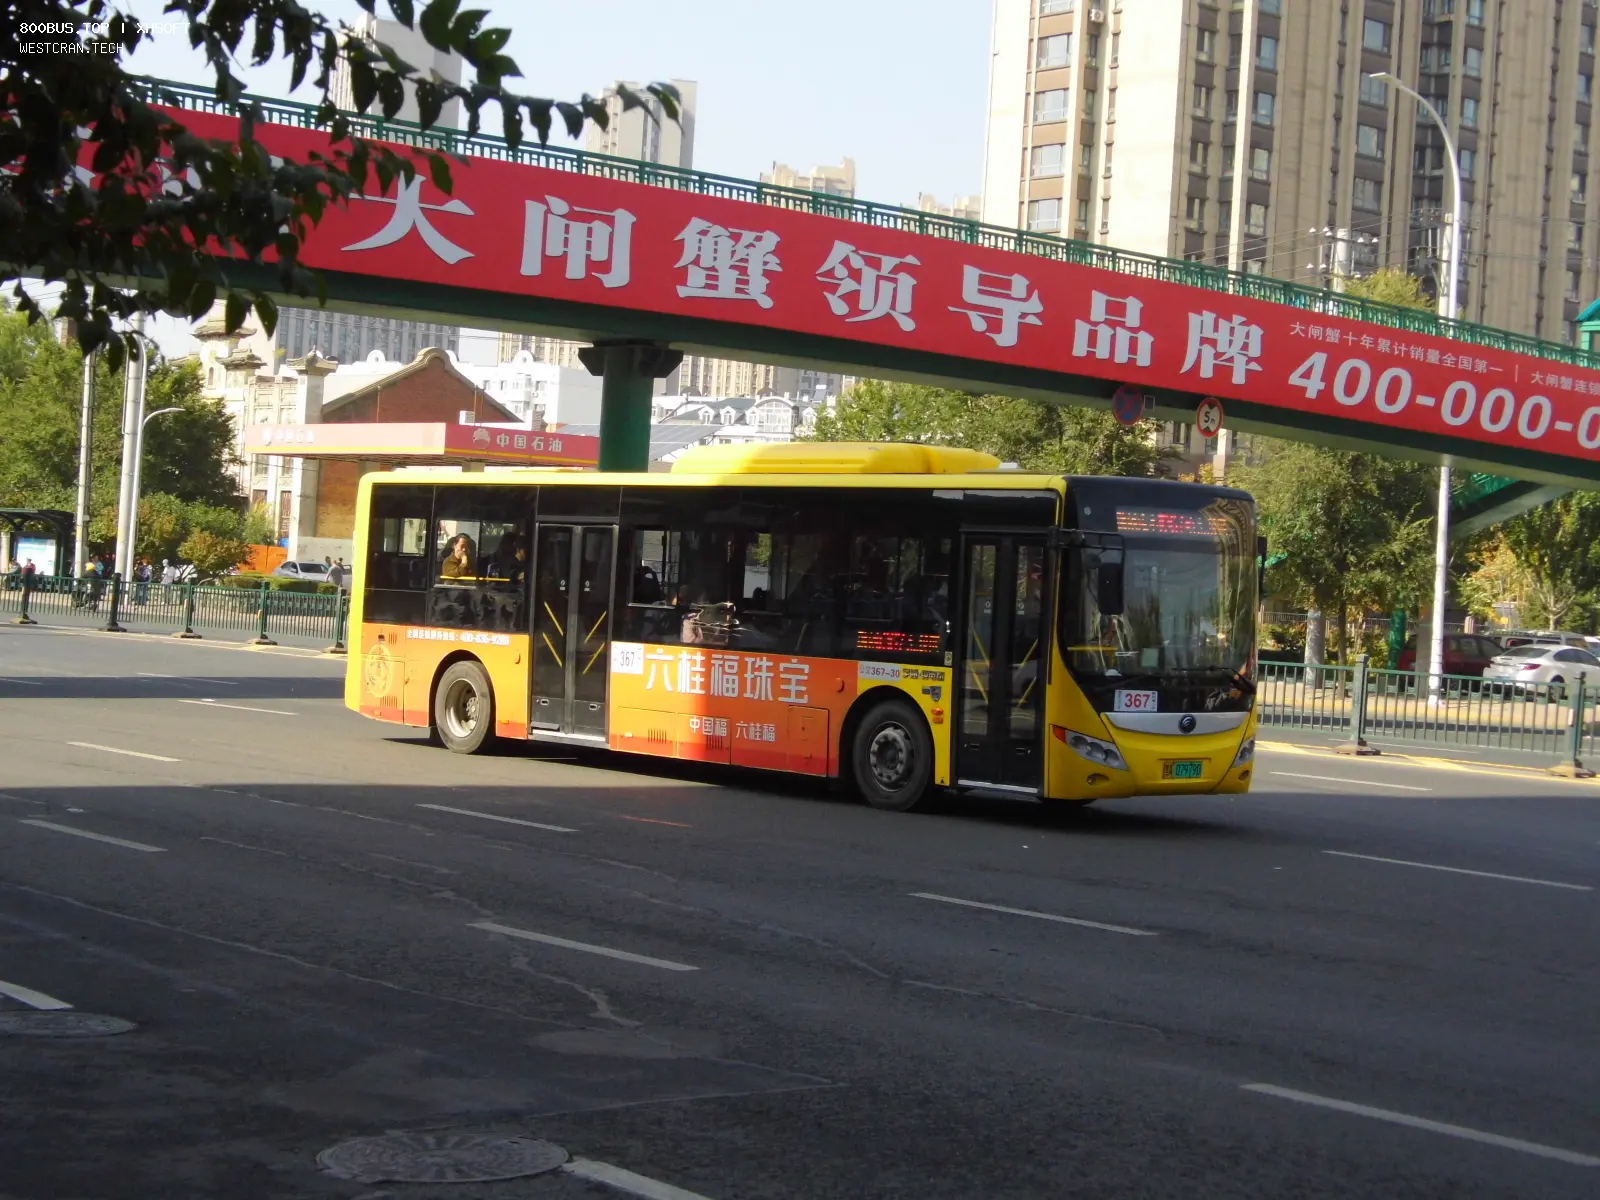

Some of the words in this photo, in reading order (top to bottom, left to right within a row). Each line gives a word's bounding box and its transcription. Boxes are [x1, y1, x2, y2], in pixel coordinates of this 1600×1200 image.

[341, 171, 1264, 384] 大闸蟹领导品牌
[1290, 321, 1504, 374] 大闸蟹十年累计销量全国第一
[496, 433, 563, 453] 中国石油
[620, 651, 635, 667] 367
[645, 648, 810, 704] 六桂福珠宝
[1124, 693, 1151, 708] 367
[690, 716, 732, 736] 中国福
[735, 720, 776, 742] 六桂福
